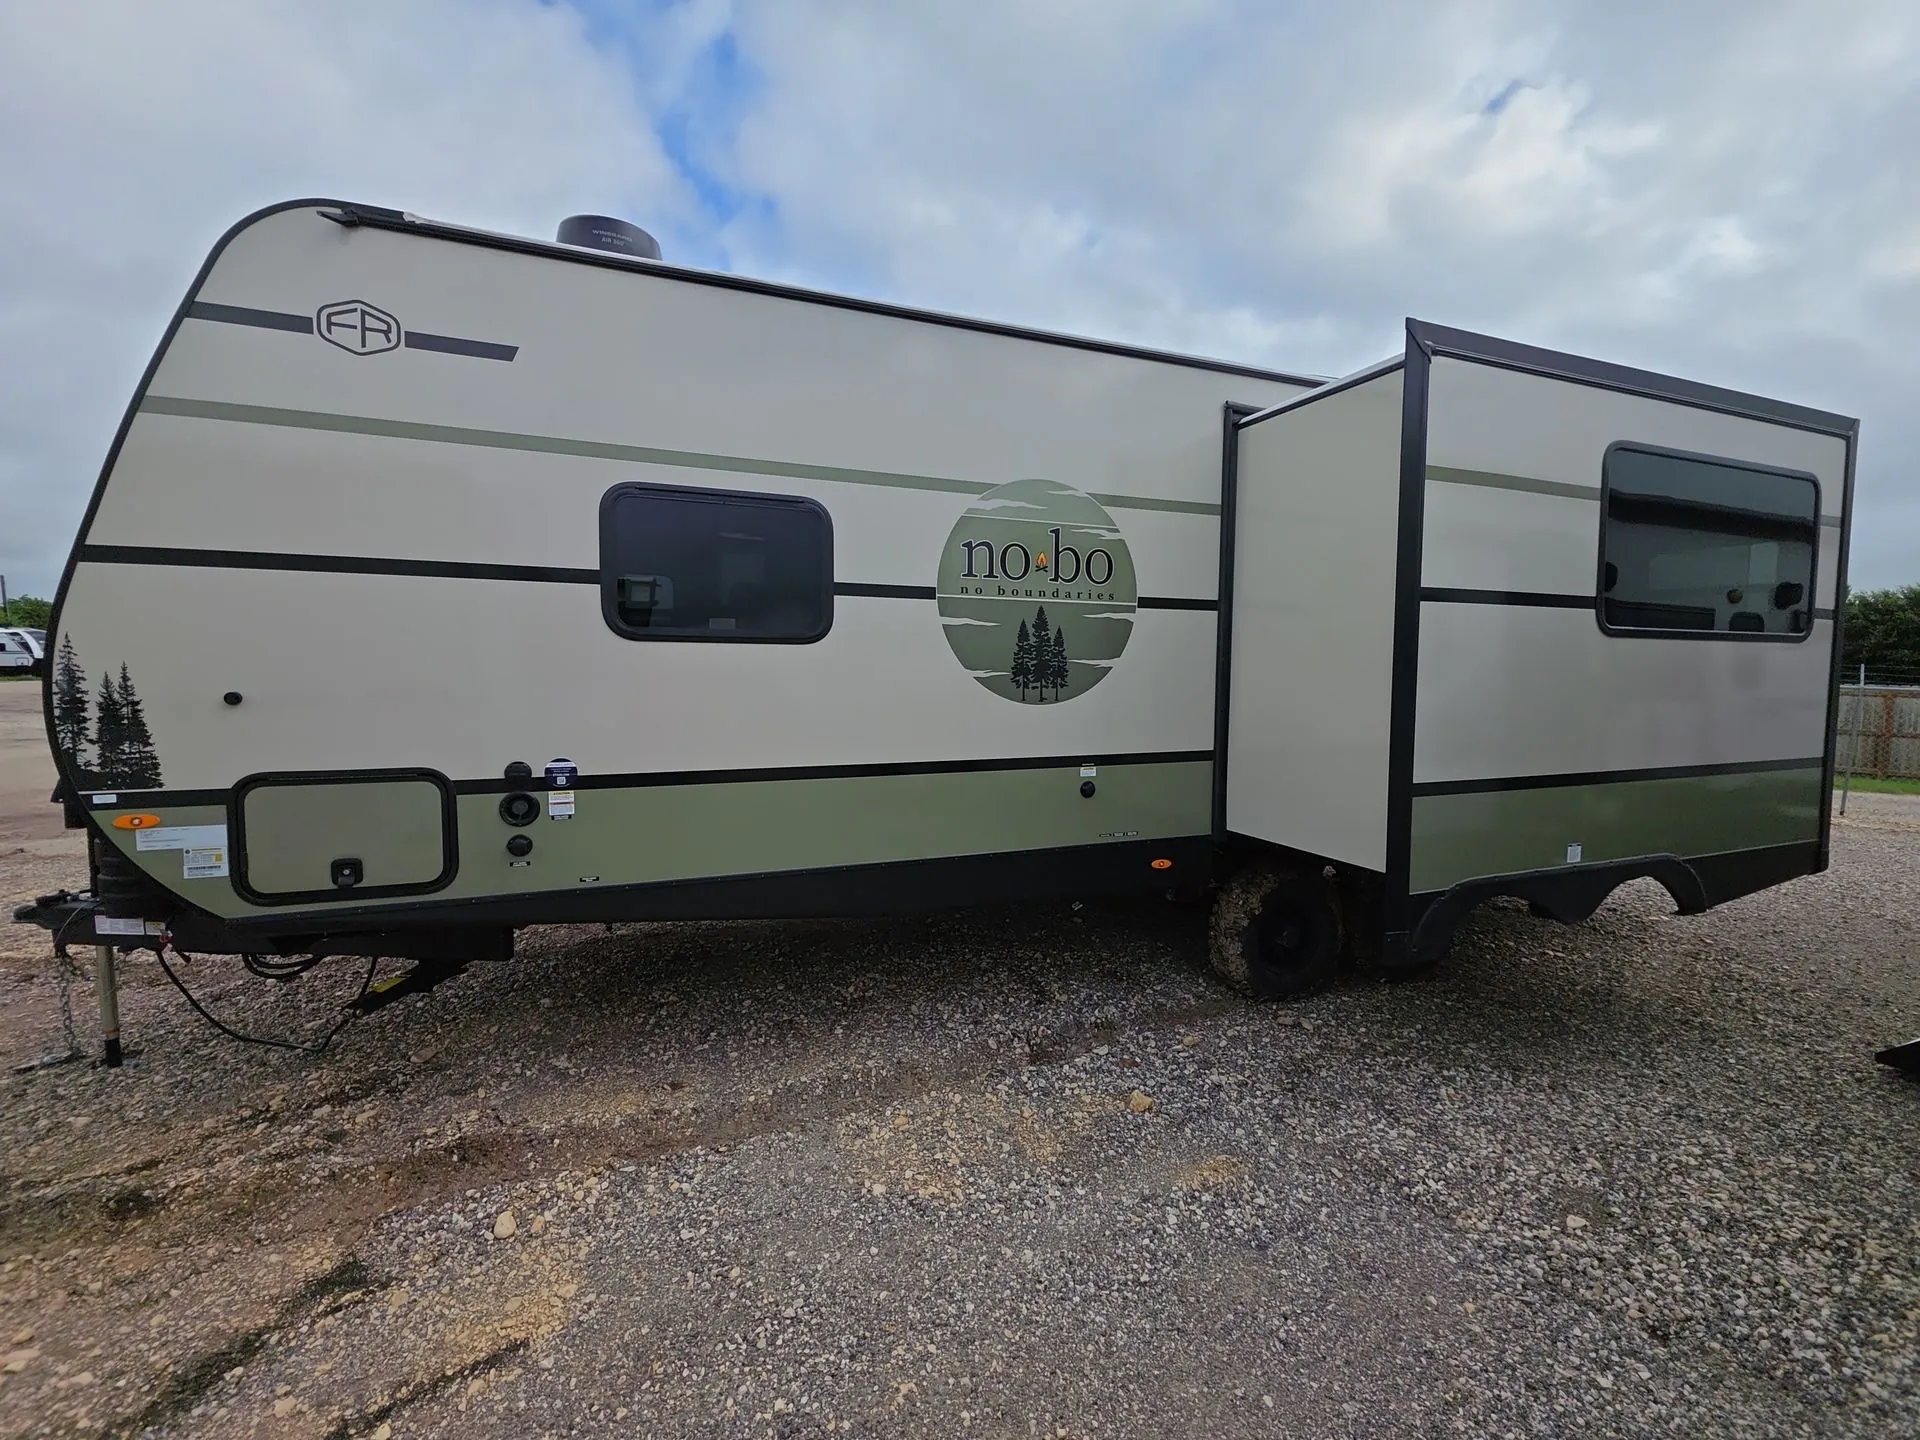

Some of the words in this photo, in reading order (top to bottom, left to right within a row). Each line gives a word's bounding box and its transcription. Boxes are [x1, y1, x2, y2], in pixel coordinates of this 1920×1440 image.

[326, 307, 392, 348] FR
[960, 586, 983, 595] no
[997, 585, 1115, 600] boundaries
